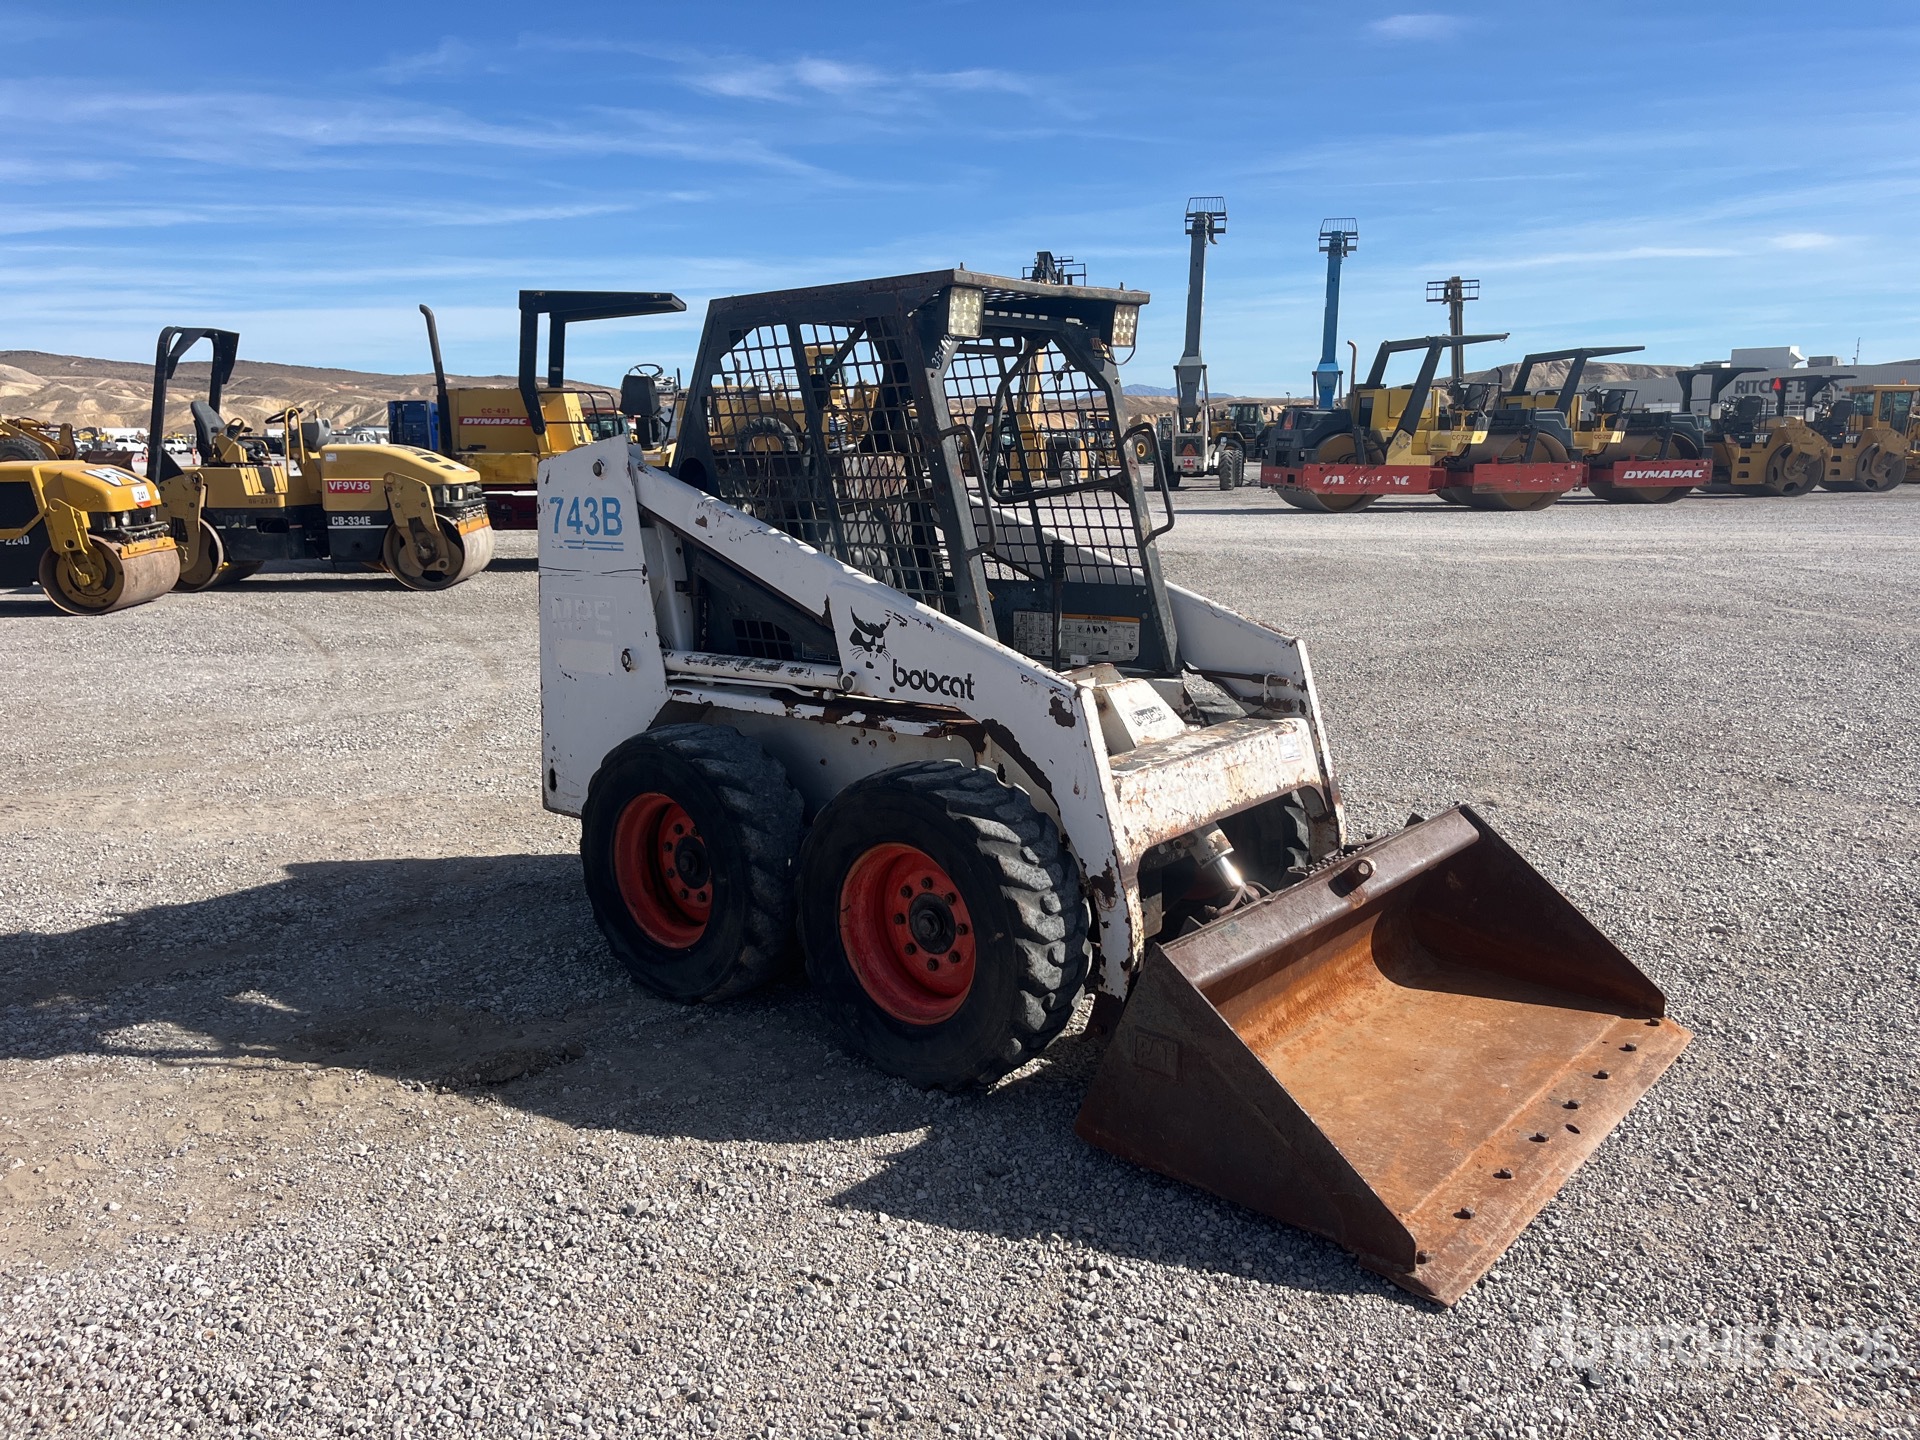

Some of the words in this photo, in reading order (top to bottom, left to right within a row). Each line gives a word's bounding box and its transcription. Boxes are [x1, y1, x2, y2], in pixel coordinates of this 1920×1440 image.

[931, 334, 956, 370] 36110
[461, 417, 529, 426] DYNAPAC
[1754, 434, 1768, 443] CAT
[1845, 435, 1858, 443] CAT
[1622, 469, 1705, 479] DYNAPAC
[329, 481, 371, 491] VF9V36
[331, 516, 371, 526] CB-334E
[549, 496, 623, 536] 743B
[892, 658, 975, 701] bobcat
